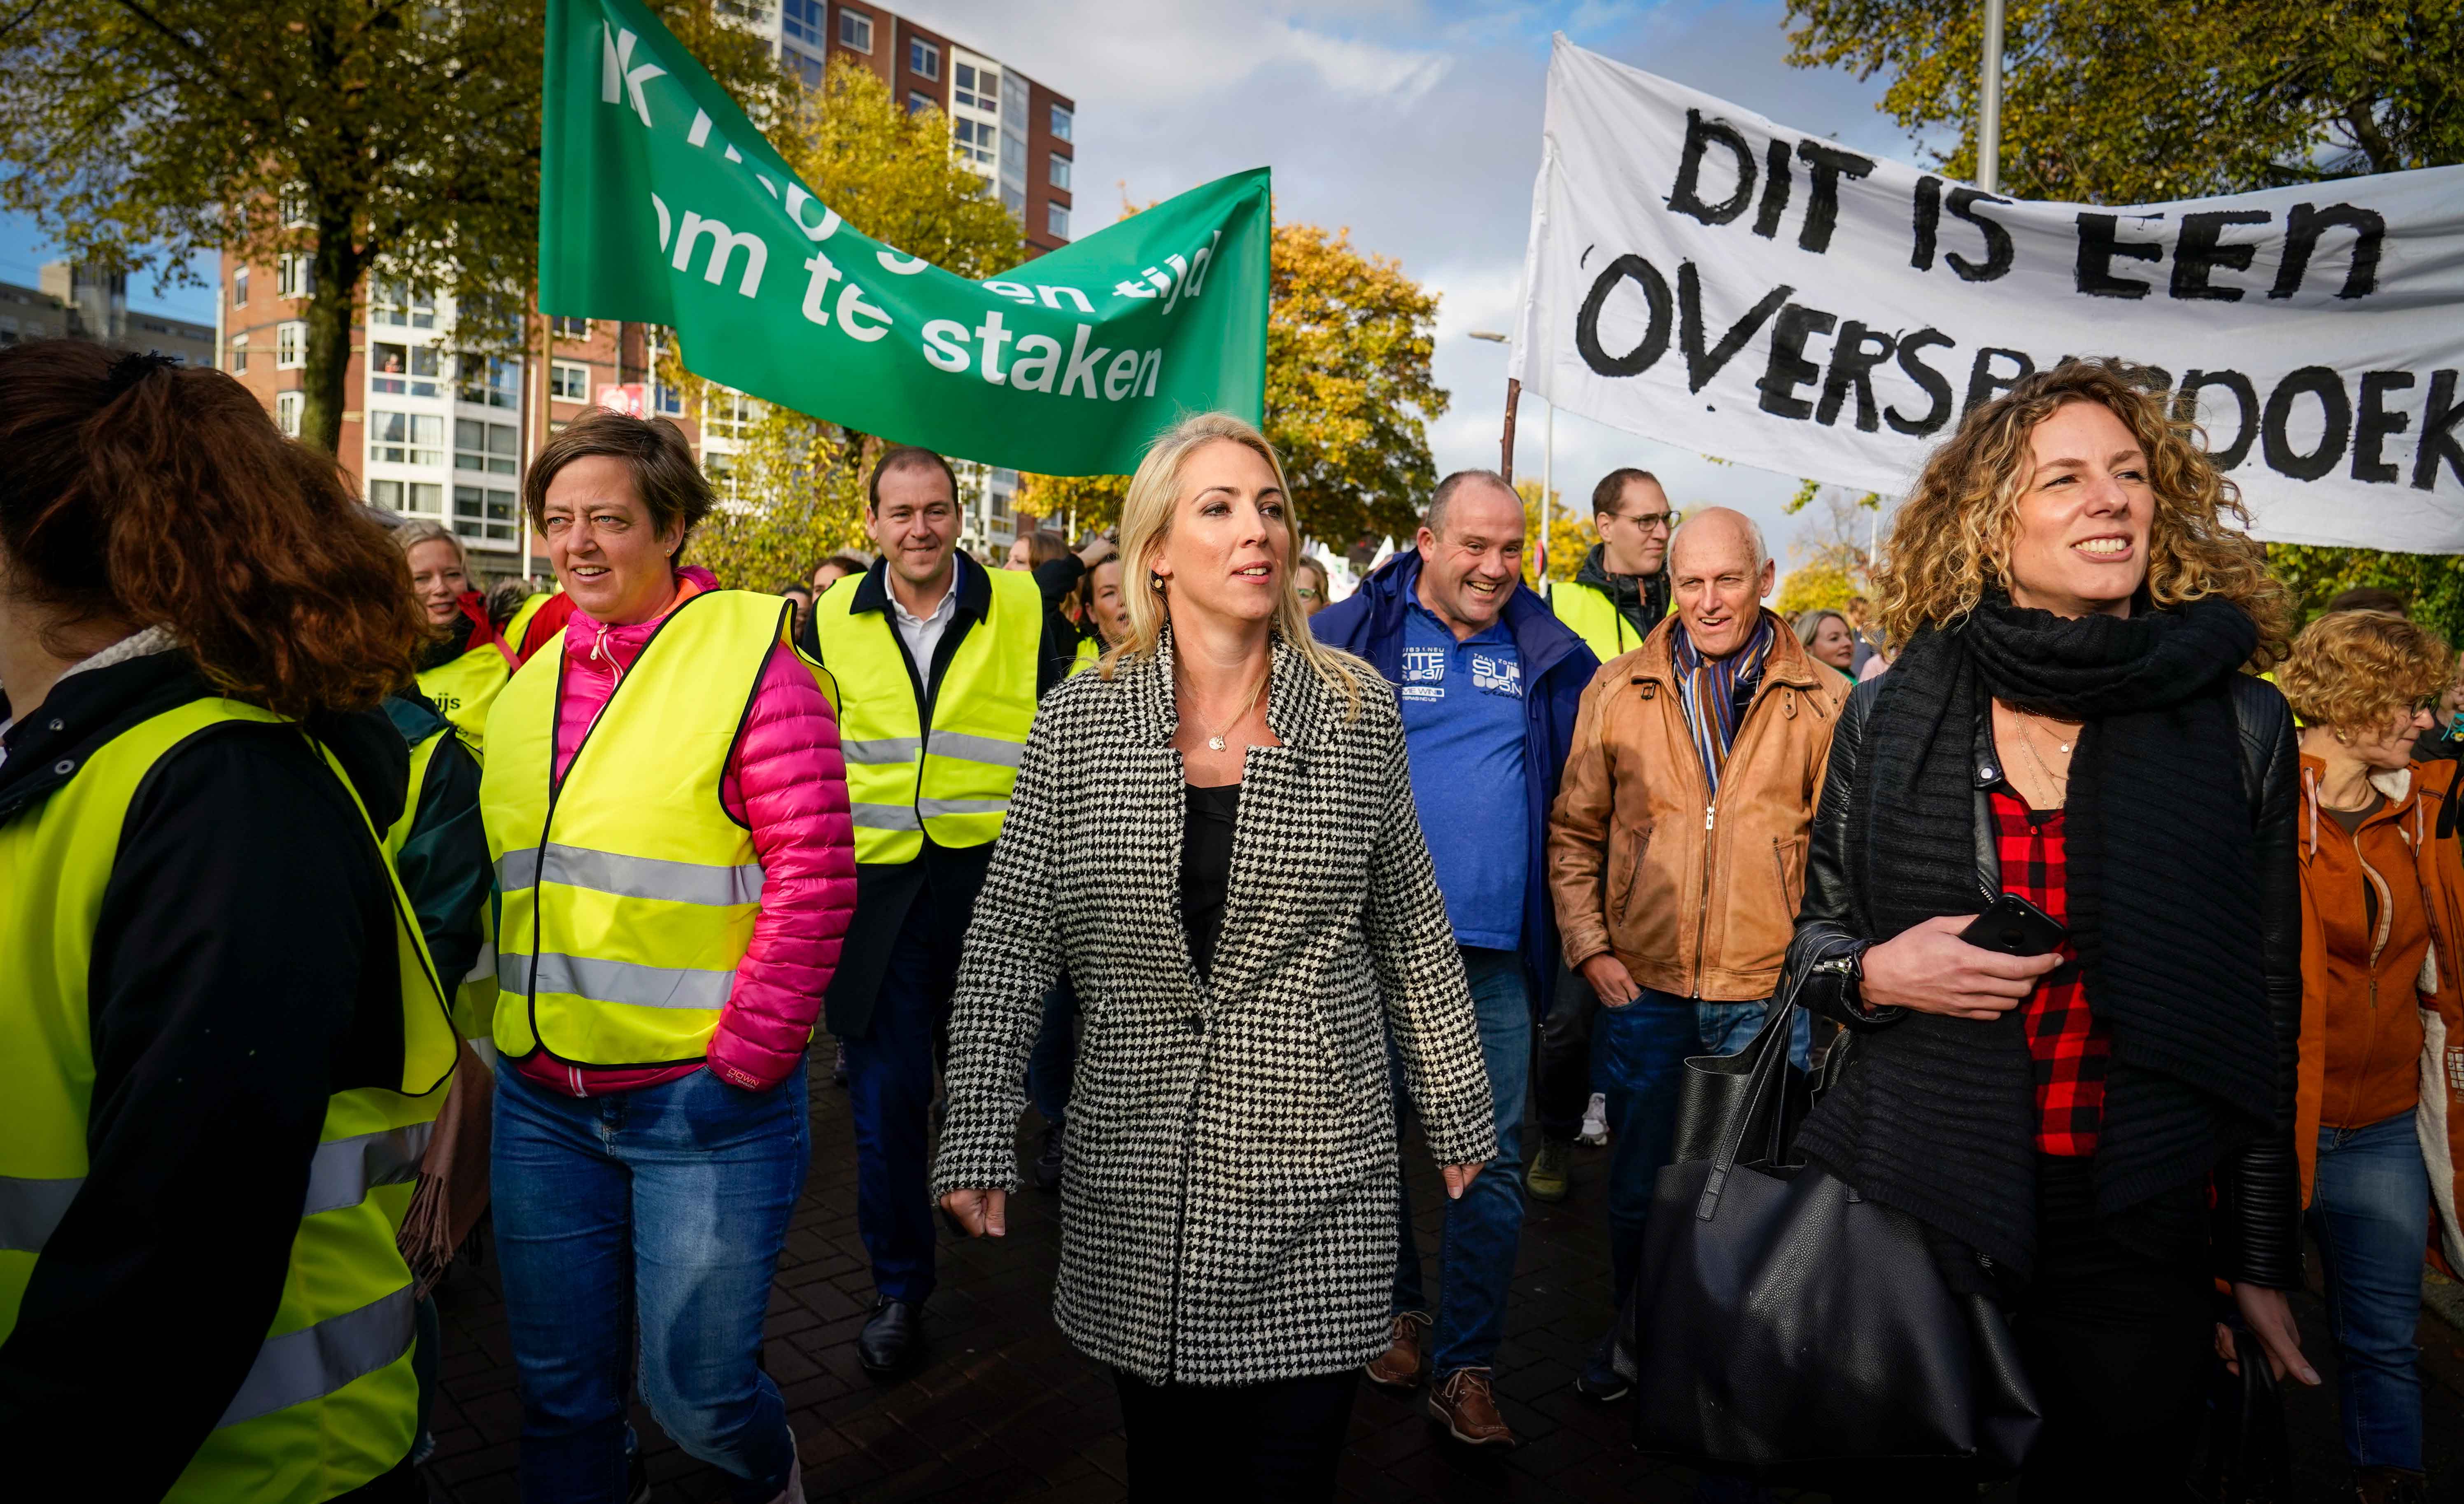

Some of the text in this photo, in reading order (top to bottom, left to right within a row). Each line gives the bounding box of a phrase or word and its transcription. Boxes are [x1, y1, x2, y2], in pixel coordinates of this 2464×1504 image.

[1662, 108, 1878, 254] DIT
[1910, 175, 2014, 283] IS
[802, 250, 893, 342] te
[921, 310, 1162, 401] staken
[728, 1068, 760, 1087] DOWN
[735, 1077, 756, 1089] TENSON
